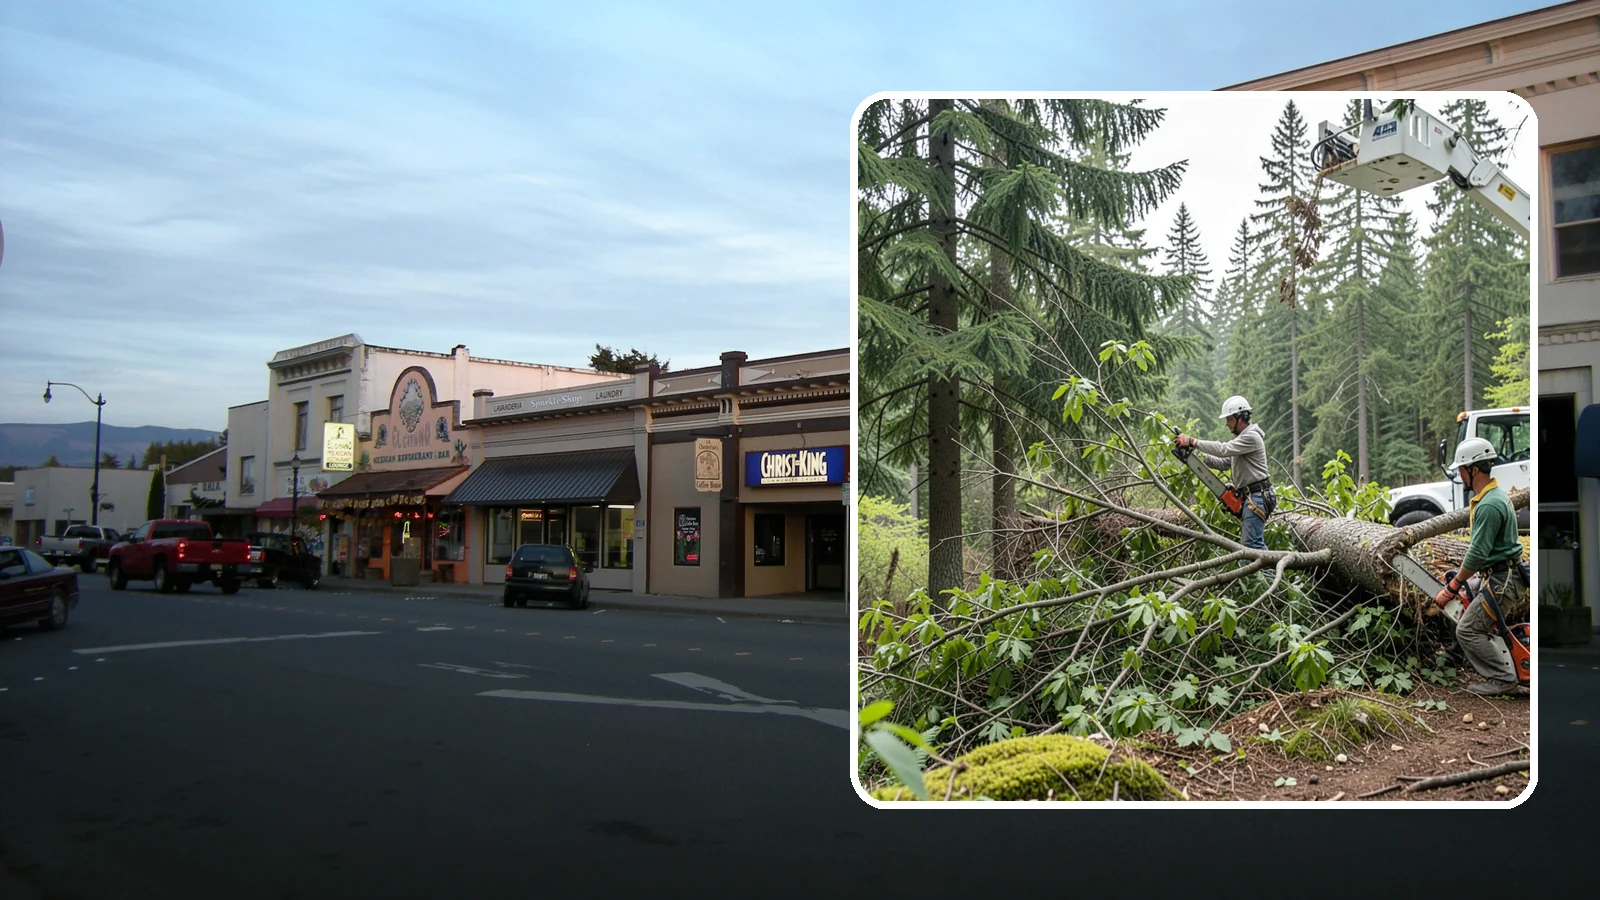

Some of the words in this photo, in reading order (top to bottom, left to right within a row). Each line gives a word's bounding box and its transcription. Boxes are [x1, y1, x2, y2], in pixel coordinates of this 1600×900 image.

[595, 389, 624, 400] LAUNDRY
[493, 402, 523, 412] LAVANDERIA
[530, 398, 560, 410] Sparkle
[561, 394, 583, 405] Shop
[374, 454, 396, 464] MEXICAN
[398, 452, 434, 463] RESTAURANT
[438, 450, 449, 459] BAR
[799, 450, 828, 476] KING
